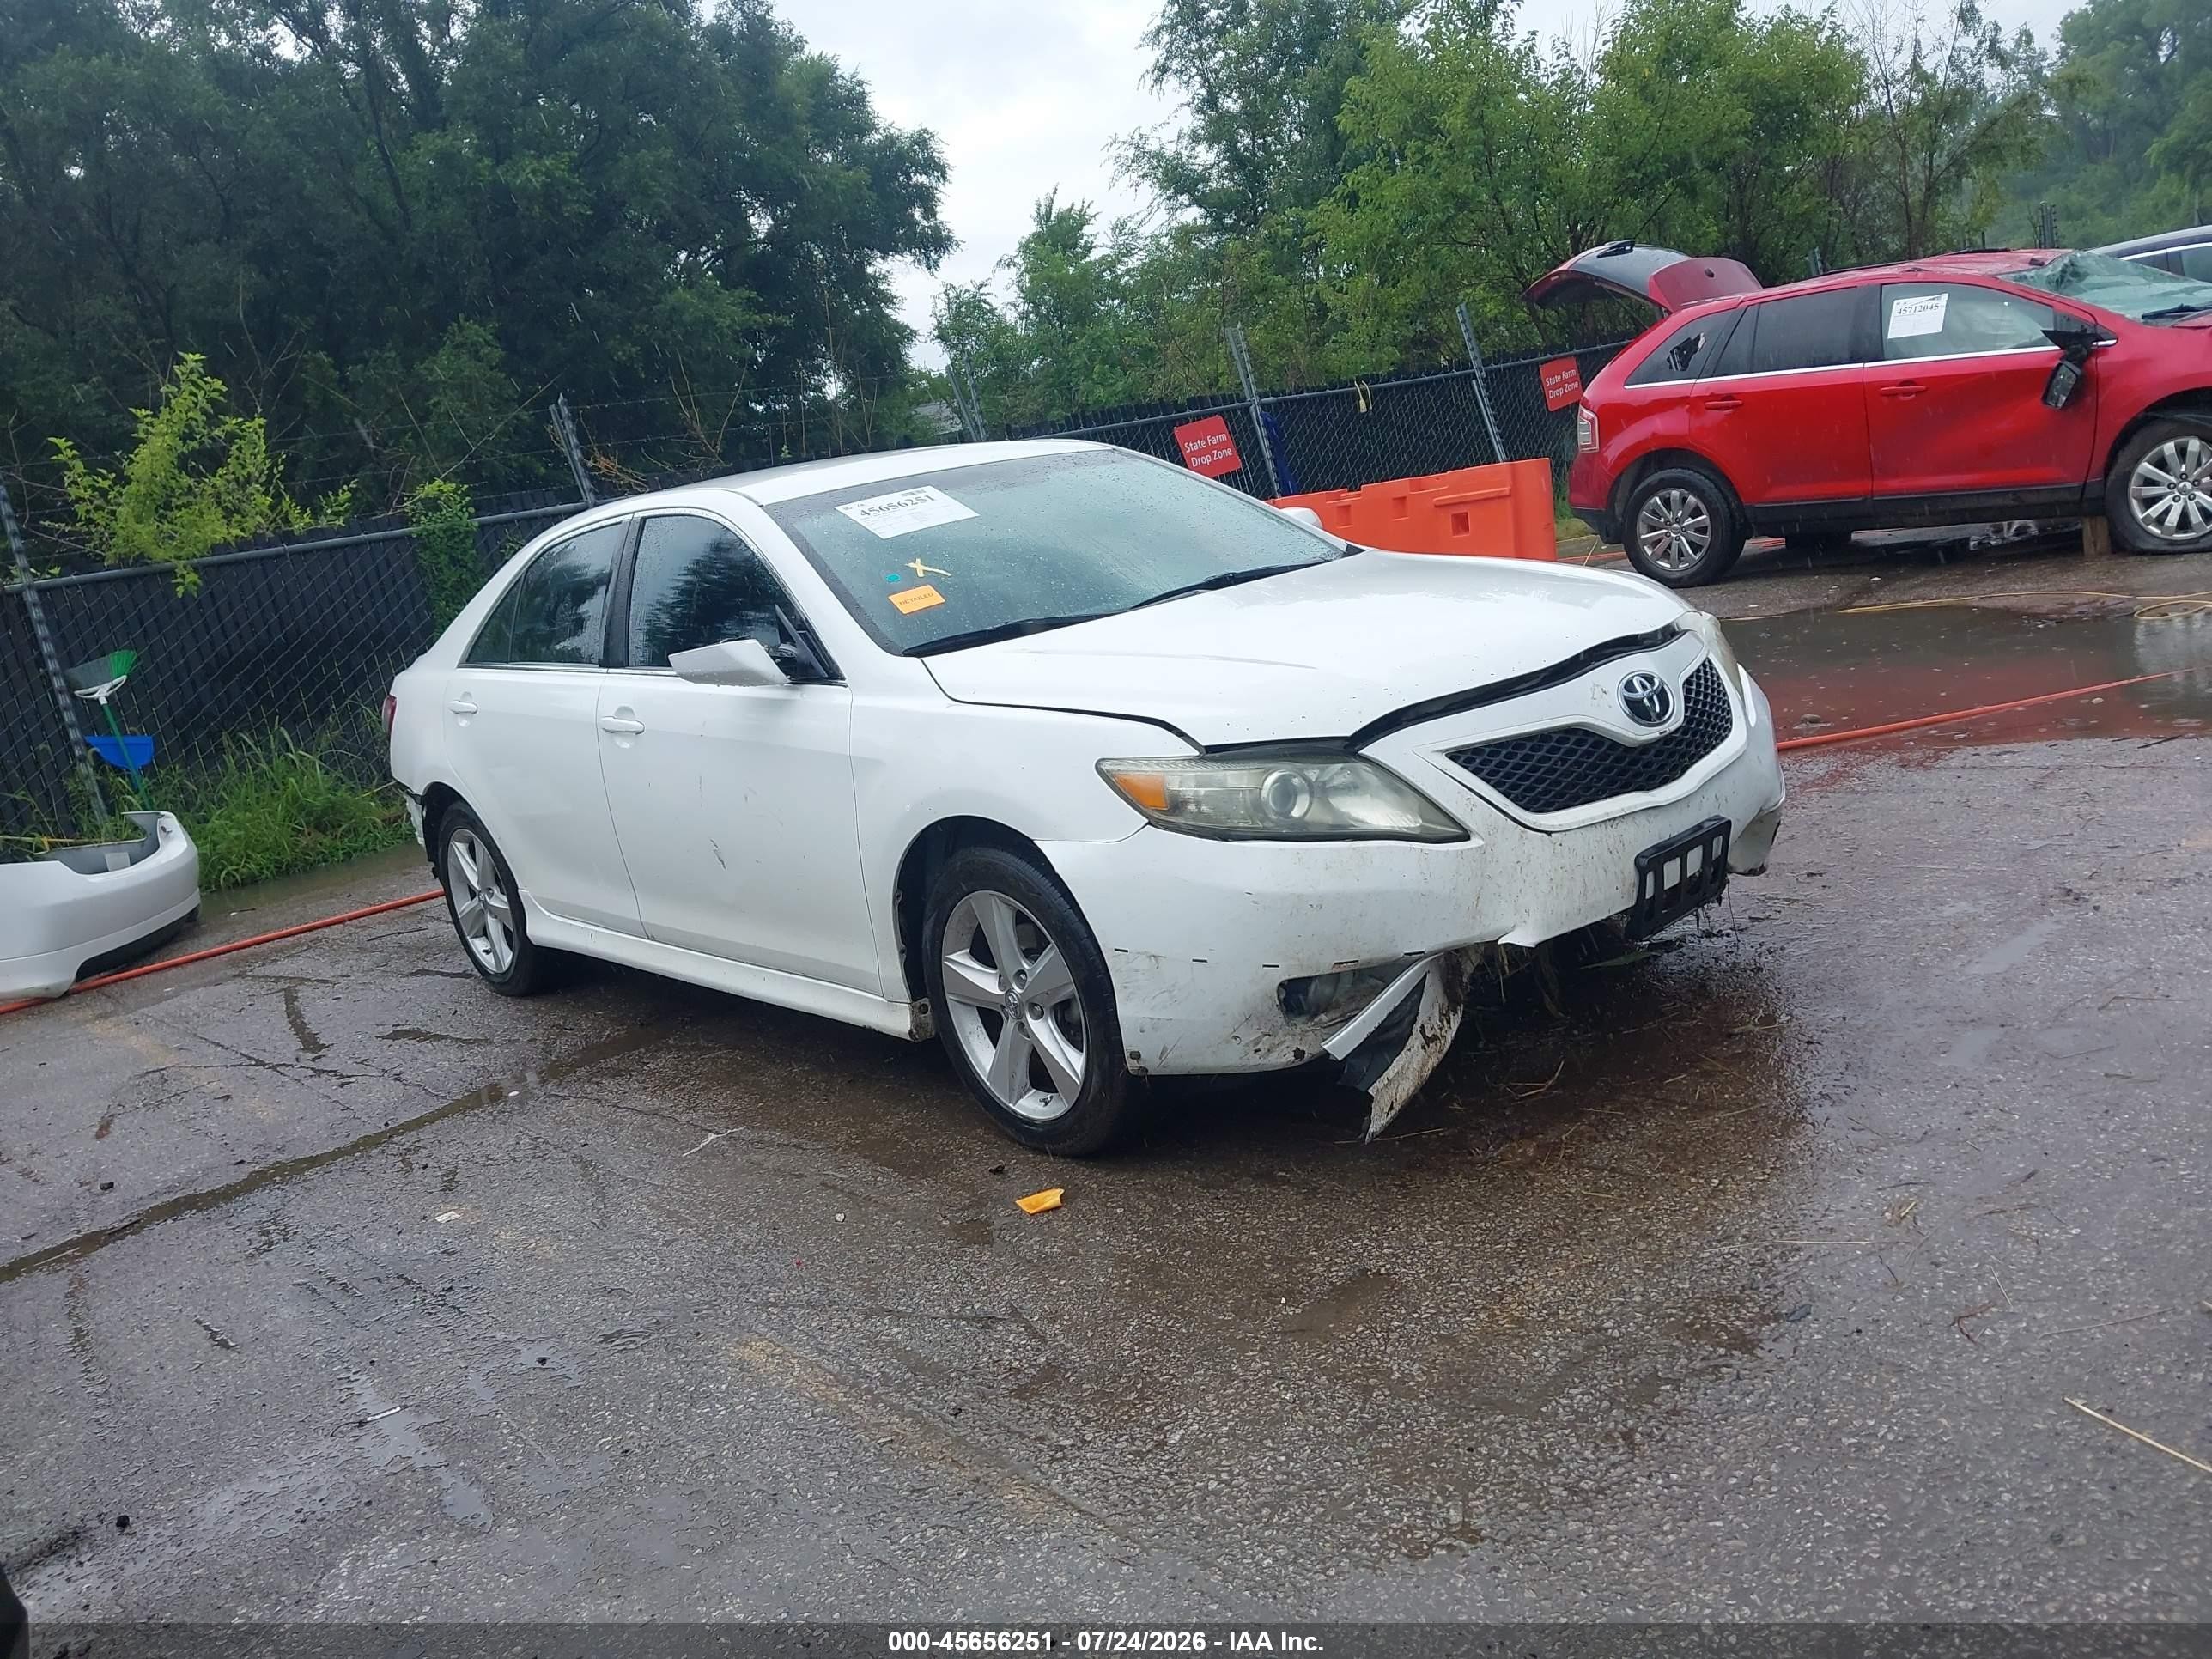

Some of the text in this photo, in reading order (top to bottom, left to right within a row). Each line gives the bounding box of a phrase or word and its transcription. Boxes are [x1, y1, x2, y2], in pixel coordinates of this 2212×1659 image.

[1897, 302, 1940, 315] 45712045
[1546, 369, 1577, 386] State Farm
[1548, 381, 1579, 398] Drop Zone
[1184, 433, 1227, 453] State Farm
[1191, 447, 1232, 467] Drop Zone
[860, 495, 935, 517] 45656251
[898, 592, 934, 606] DETAILED
